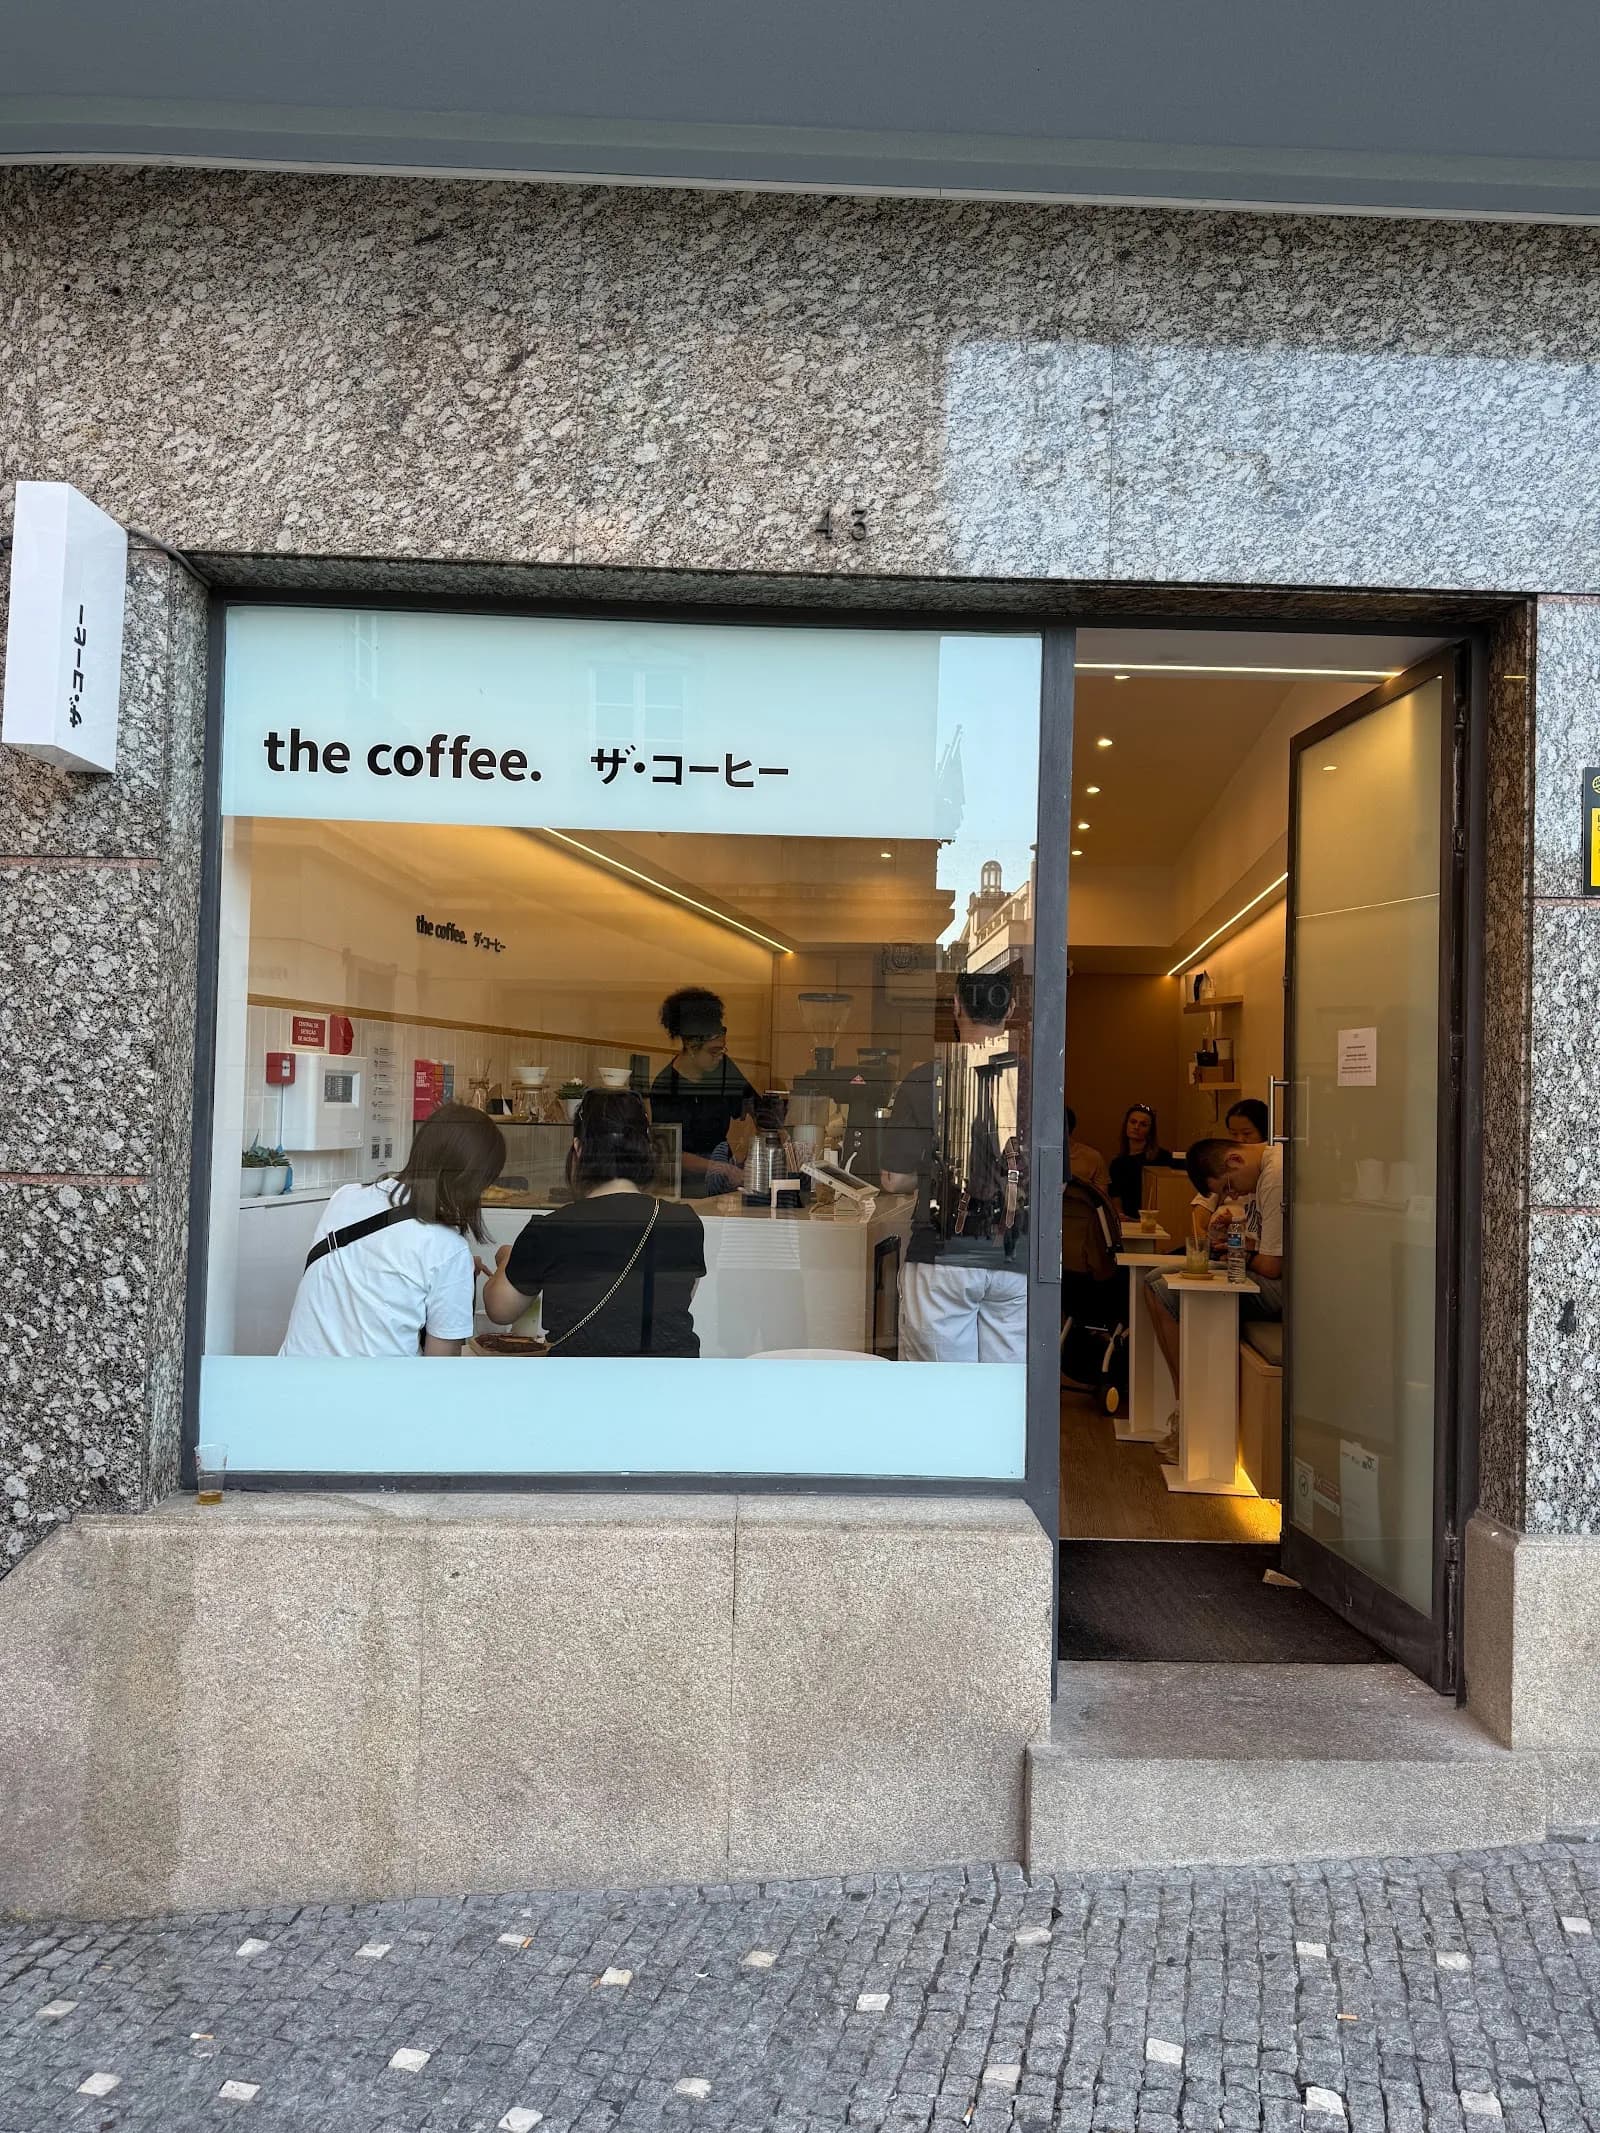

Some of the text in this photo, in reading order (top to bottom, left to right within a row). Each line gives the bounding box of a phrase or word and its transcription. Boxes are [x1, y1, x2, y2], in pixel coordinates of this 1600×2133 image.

[815, 507, 868, 541] 43
[264, 729, 350, 773] the
[368, 734, 541, 781] coffee.
[415, 914, 434, 937] the
[435, 921, 468, 945] coffee.
